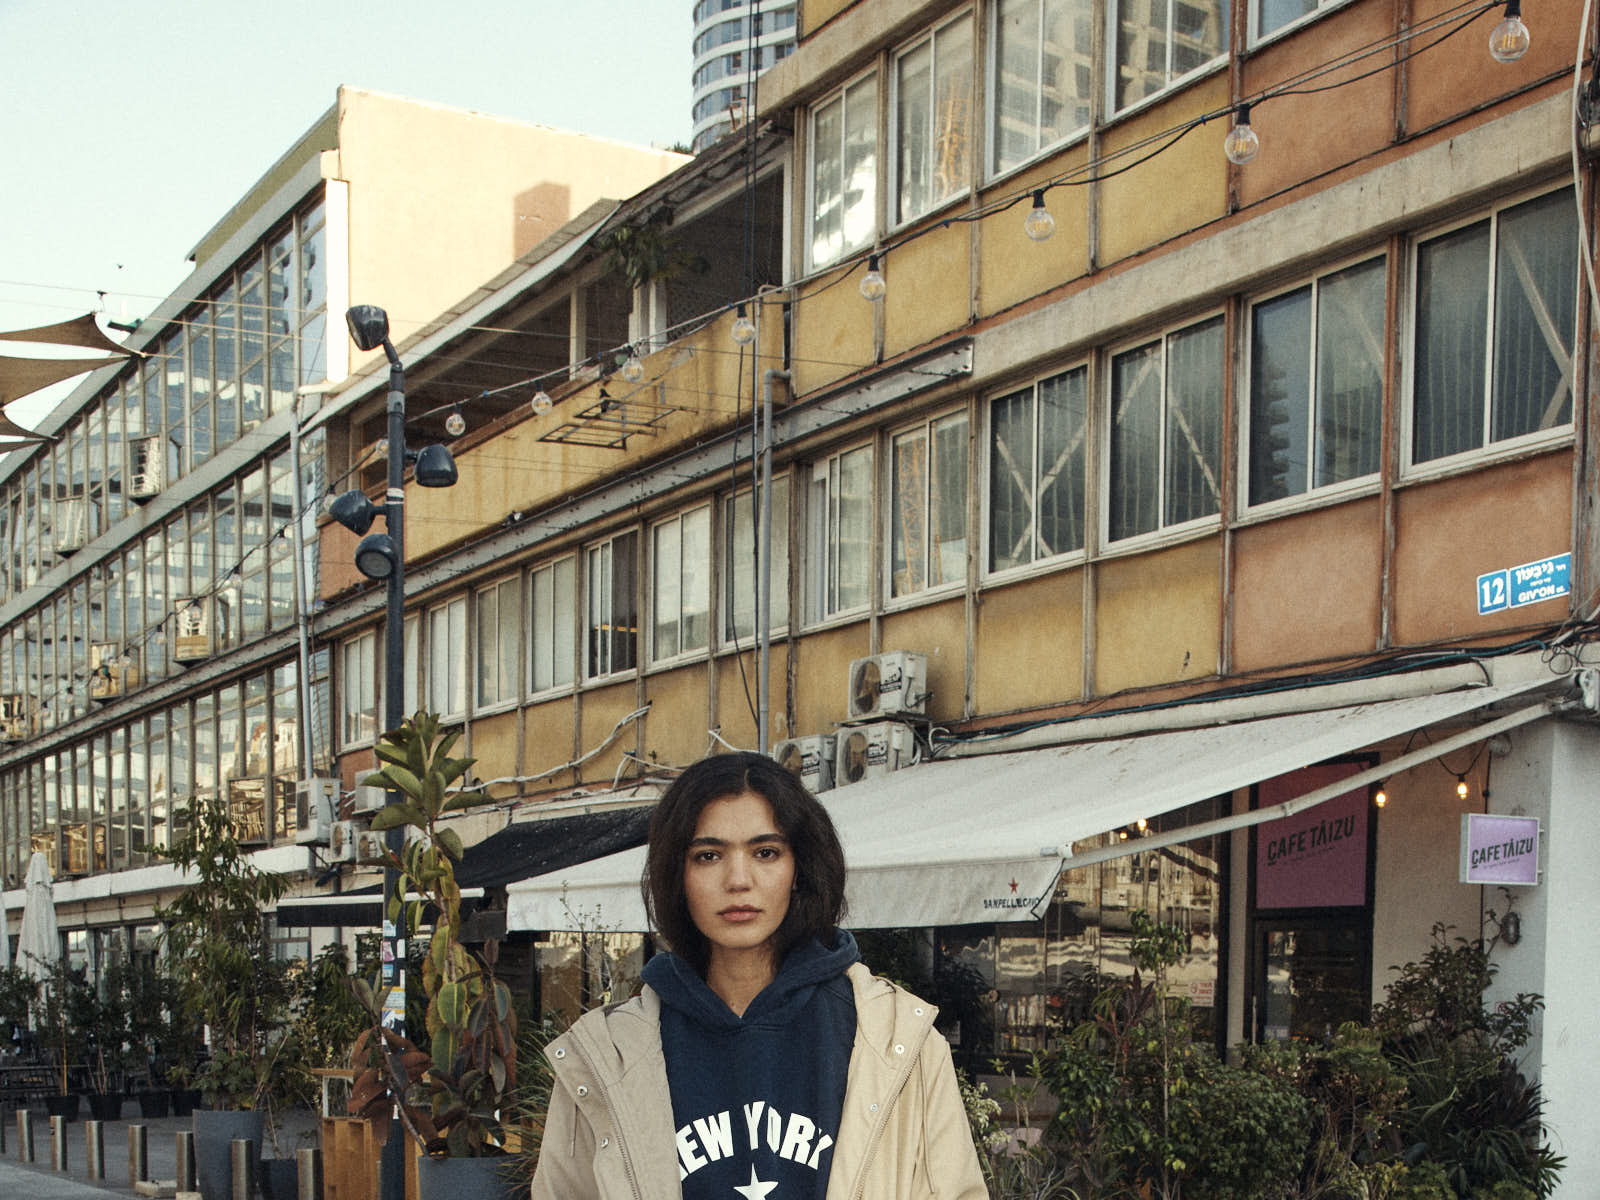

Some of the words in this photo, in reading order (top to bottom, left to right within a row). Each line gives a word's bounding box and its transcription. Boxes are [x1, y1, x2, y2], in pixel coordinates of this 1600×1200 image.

[1481, 577, 1505, 608] 12
[1518, 584, 1555, 602] GIV'ON
[1267, 831, 1306, 863] CAFE
[1471, 844, 1501, 867] CAFE
[676, 1110, 735, 1182] EW
